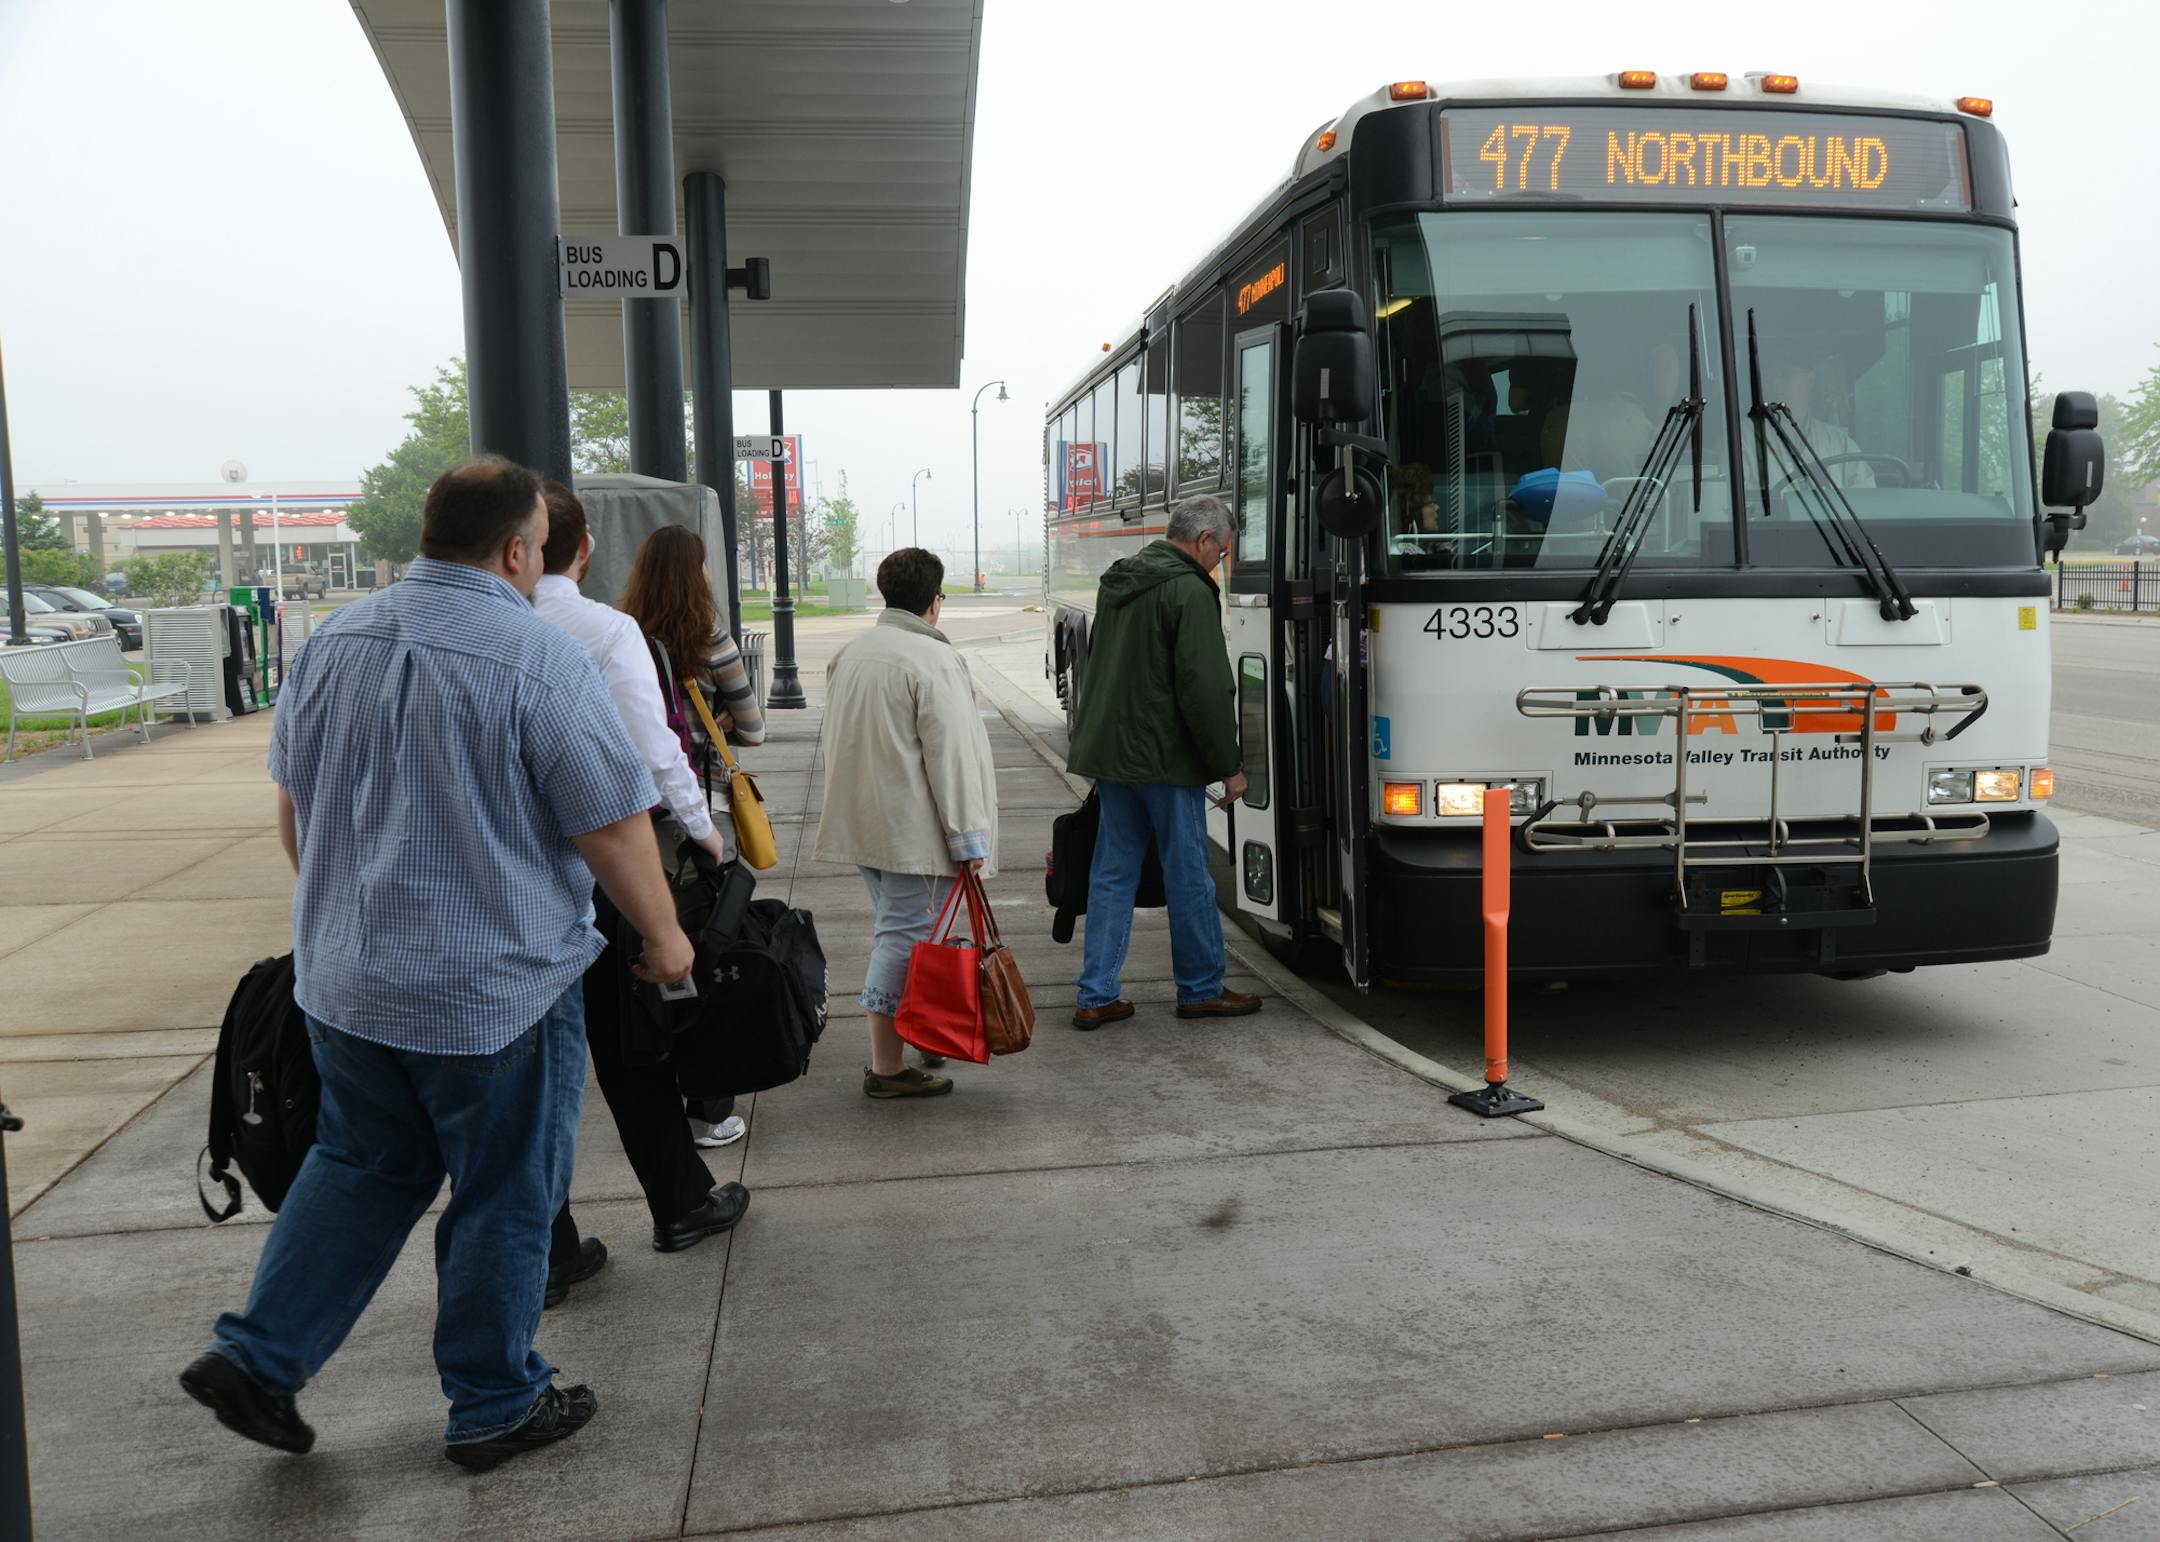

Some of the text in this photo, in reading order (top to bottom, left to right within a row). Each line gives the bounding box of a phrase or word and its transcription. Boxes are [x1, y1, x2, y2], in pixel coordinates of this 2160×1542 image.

[1478, 124, 1889, 191] 477 NORTHBOUND
[566, 246, 603, 264] BUS
[652, 243, 681, 291] D
[567, 270, 648, 288] LOADING
[736, 440, 752, 448] BUS
[737, 449, 770, 458] LOADING
[771, 438, 783, 458] D
[754, 471, 795, 481] Holay
[1423, 606, 1519, 640] 4333
[1574, 751, 1673, 766] Minnesota
[1808, 745, 1891, 760] Authoty
